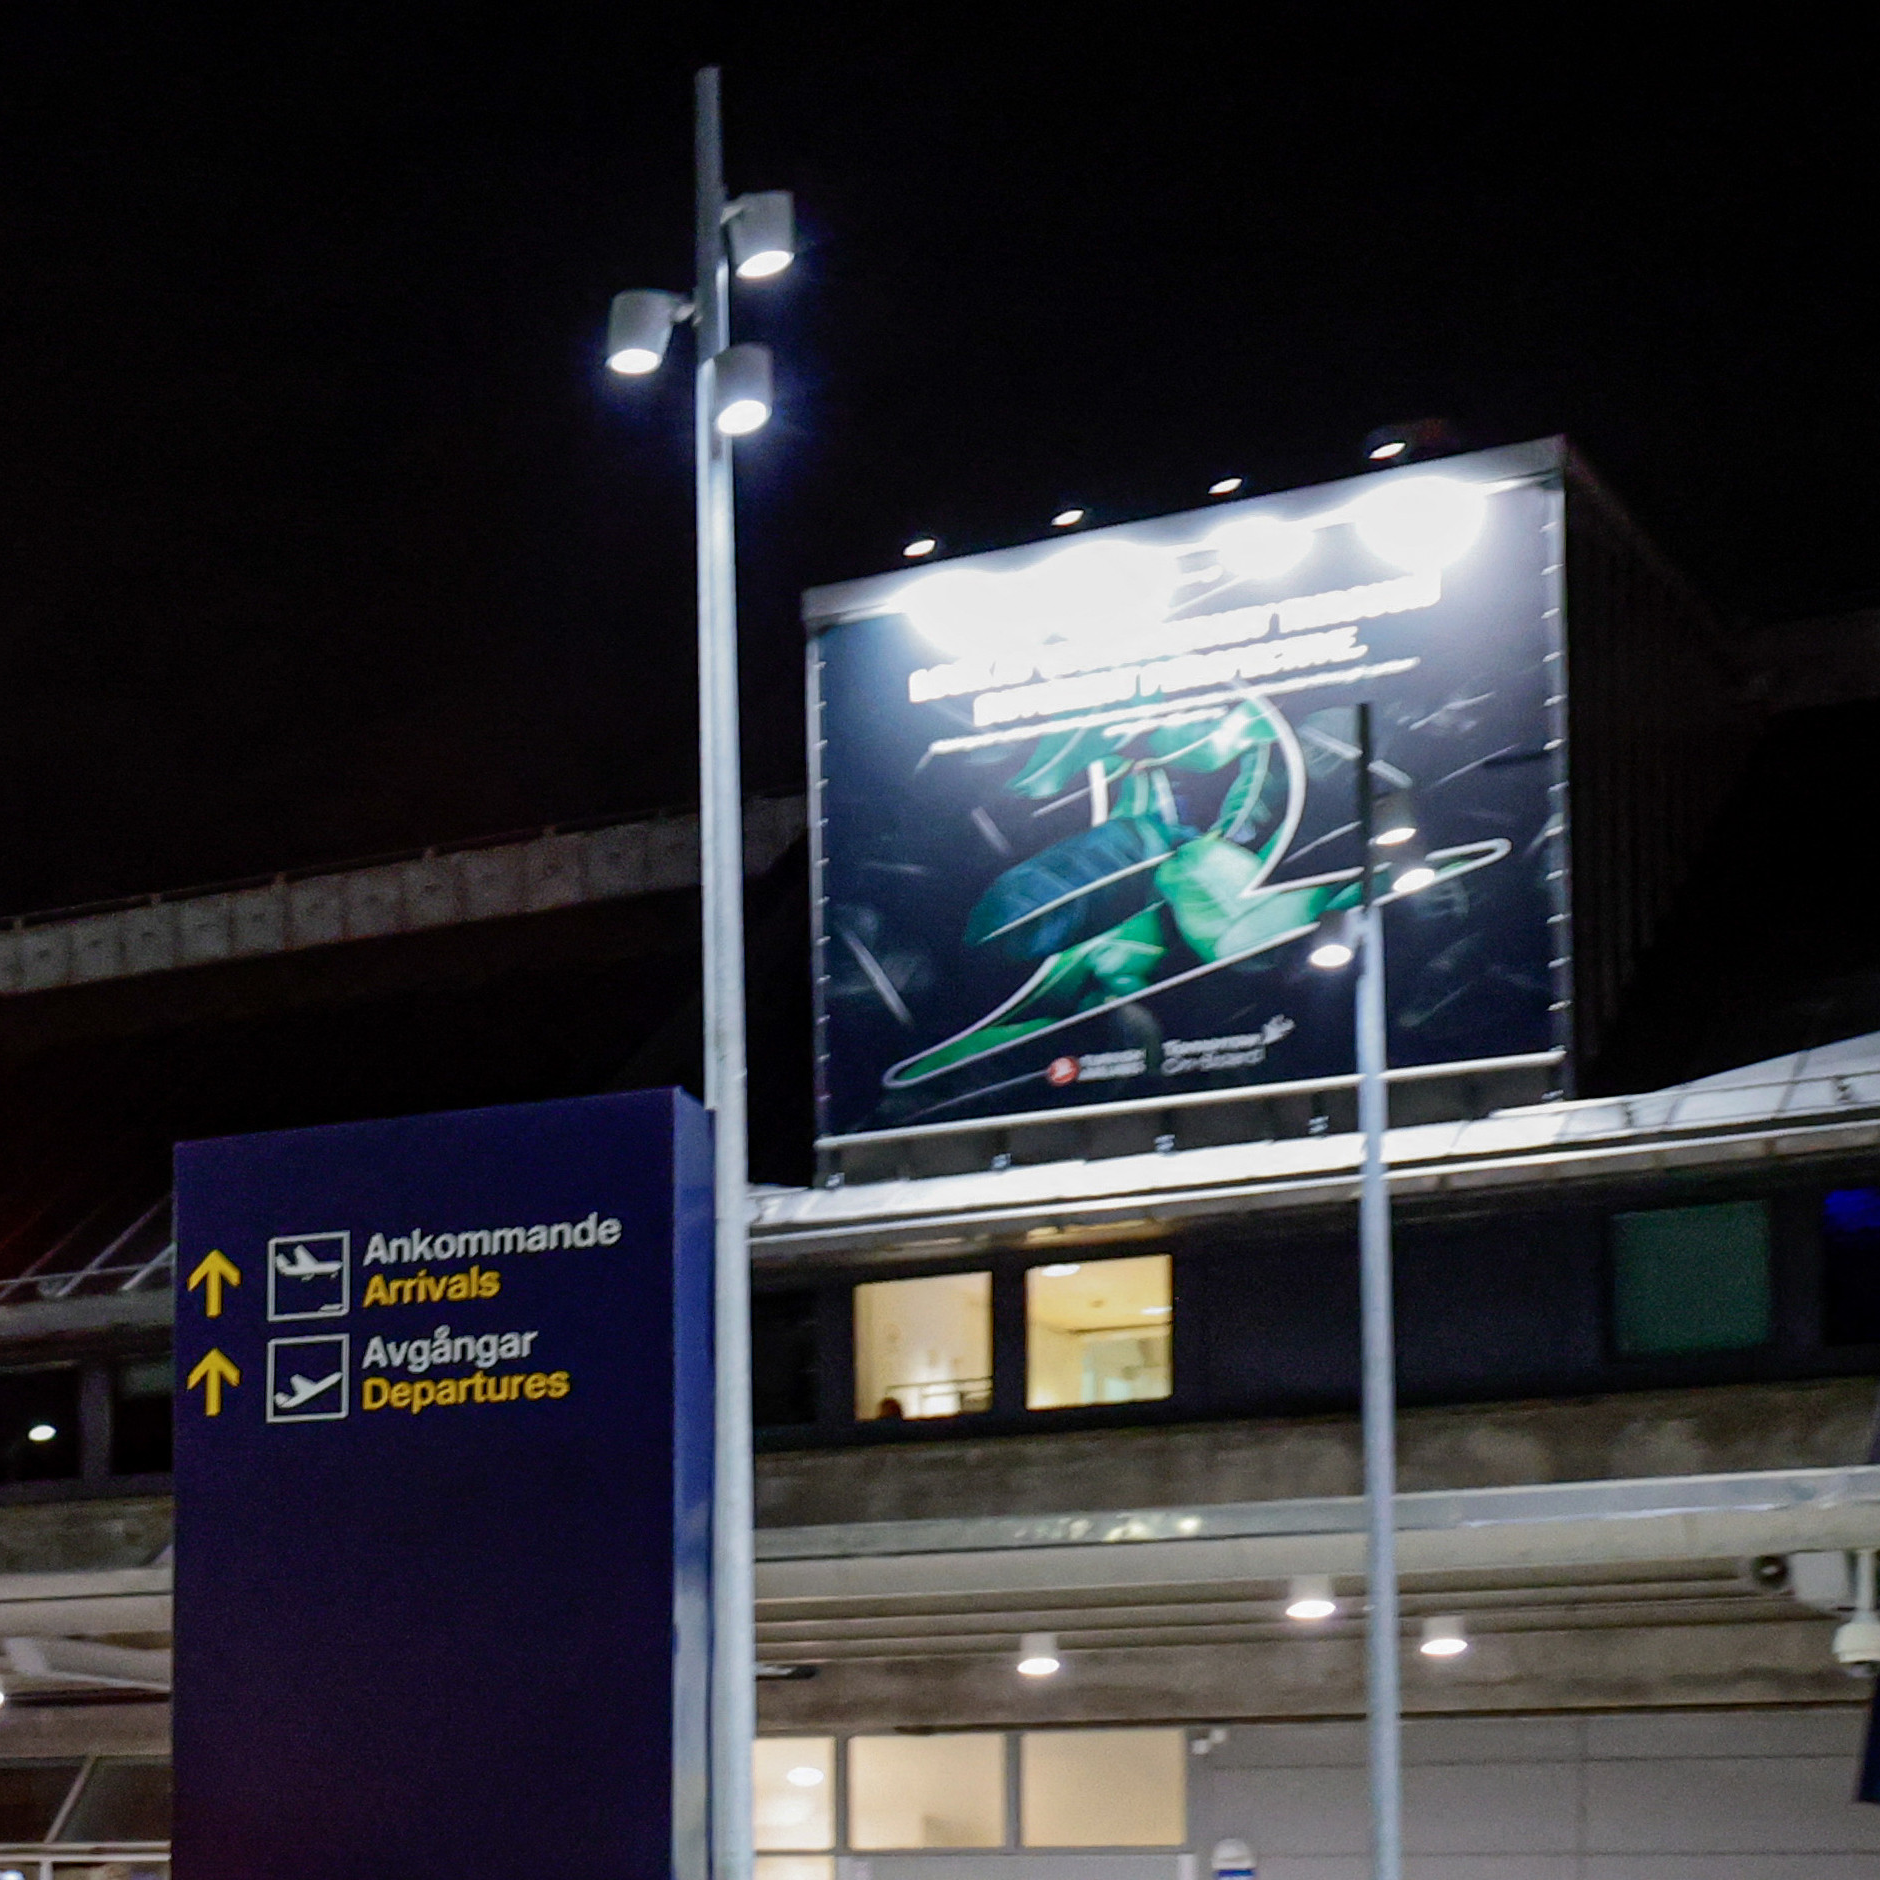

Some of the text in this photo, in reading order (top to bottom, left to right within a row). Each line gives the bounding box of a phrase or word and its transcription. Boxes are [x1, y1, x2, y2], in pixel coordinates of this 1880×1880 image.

[362, 1212, 623, 1267] Ankommande
[362, 1265, 502, 1308] Arrivals
[362, 1325, 539, 1374] Avgångar
[362, 1369, 571, 1414] Departures
